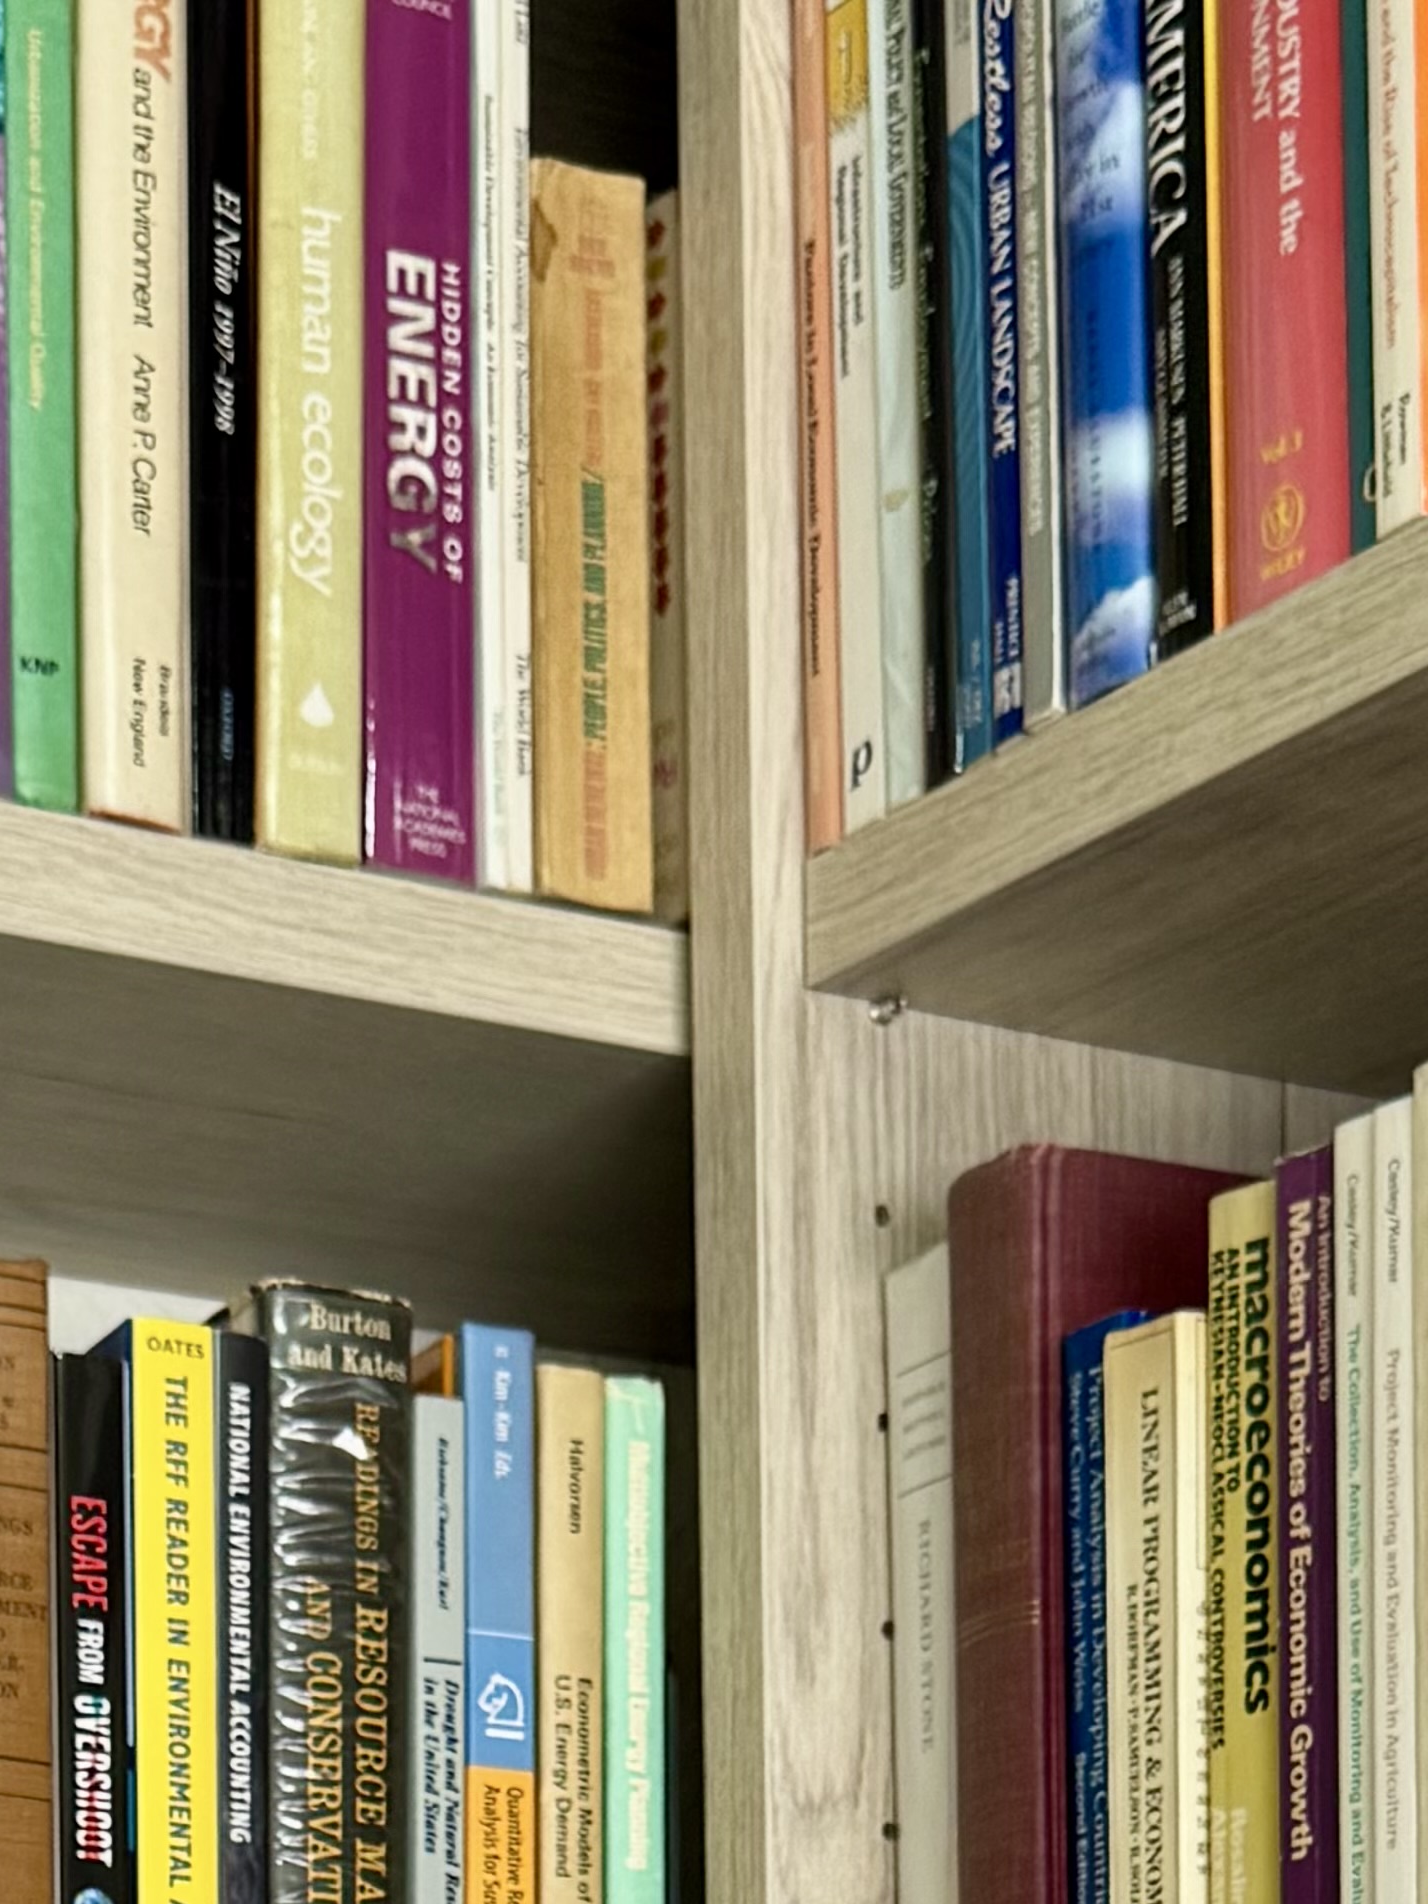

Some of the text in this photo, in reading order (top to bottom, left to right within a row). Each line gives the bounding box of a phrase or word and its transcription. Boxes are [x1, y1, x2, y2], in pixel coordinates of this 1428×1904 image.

[132, 354, 155, 537] Anne Carter
[289, 207, 338, 598] human ecology
[384, 248, 438, 574] ENERGY
[441, 260, 462, 582] HIDDEN COSTS OF
[987, 167, 1018, 458] URBAN LANDSCAPE
[146, 1337, 205, 1359] OATES
[1243, 1236, 1274, 1716] macroeconomics
[72, 1495, 112, 1867] ESCAPE FROM OVERSHOOT
